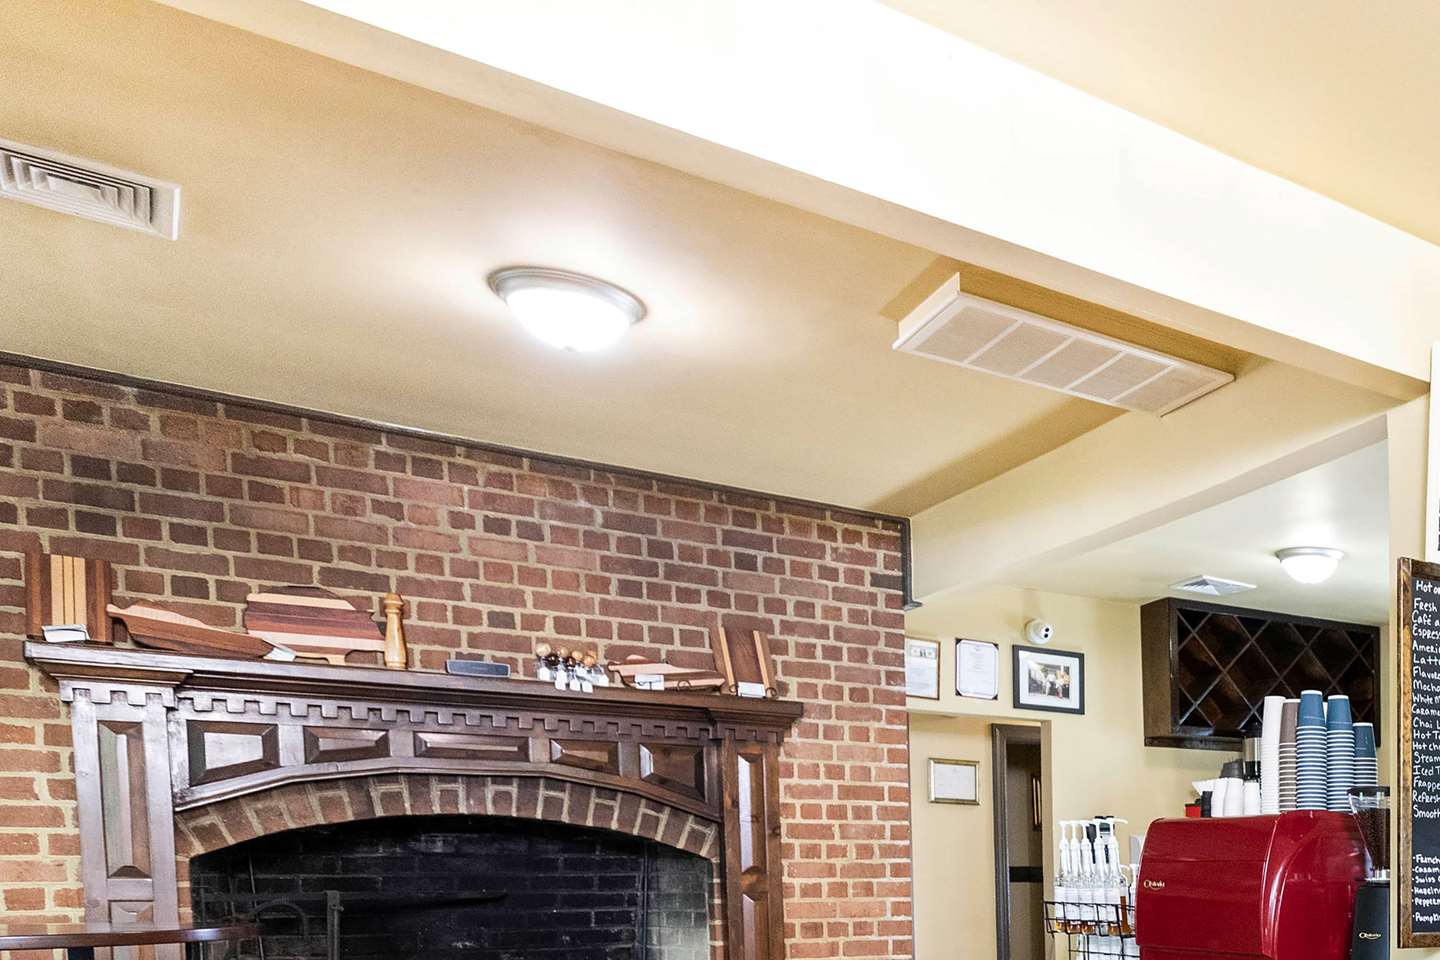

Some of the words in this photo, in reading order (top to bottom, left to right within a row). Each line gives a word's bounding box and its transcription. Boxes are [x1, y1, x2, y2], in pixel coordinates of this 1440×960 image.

[1416, 580, 1432, 592] Hot
[1414, 598, 1437, 612] Fresh
[1412, 610, 1431, 625] Café
[1412, 693, 1433, 704] White
[1413, 717, 1432, 728] Chai
[1413, 729, 1431, 739] Hot
[1412, 742, 1427, 751] Hot
[1413, 765, 1434, 776] Iced
